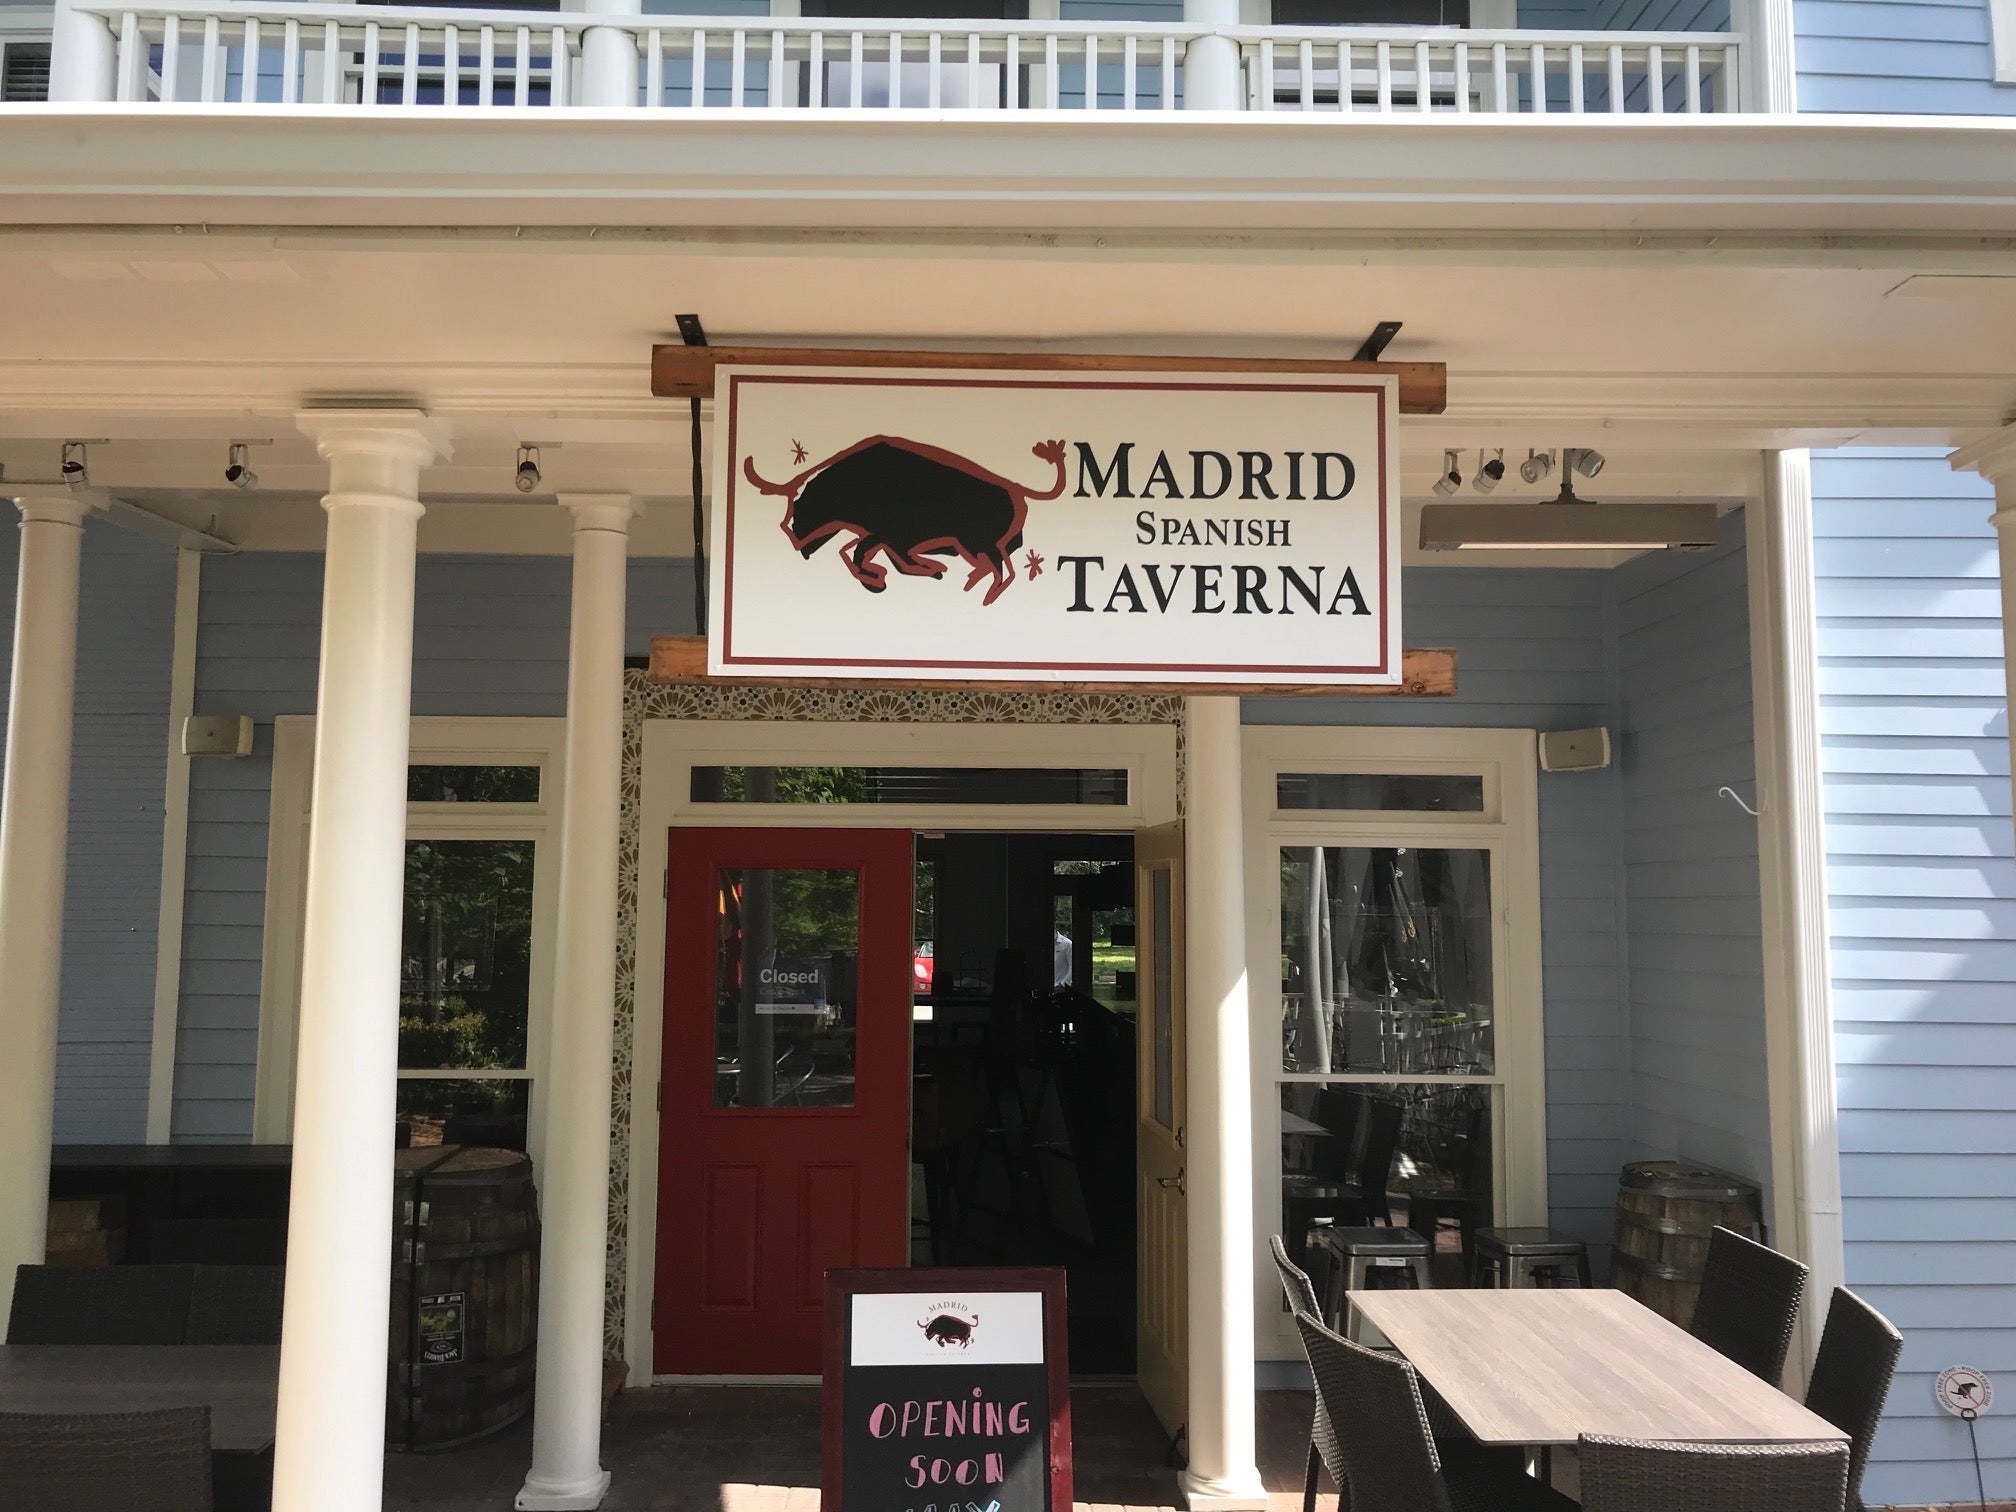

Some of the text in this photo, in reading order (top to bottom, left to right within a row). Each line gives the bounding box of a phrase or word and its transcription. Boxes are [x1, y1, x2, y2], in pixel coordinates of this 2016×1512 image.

[1073, 441, 1356, 500] MADRID
[1135, 510, 1292, 546] SPANISH
[1057, 555, 1372, 615] TAVERNA
[760, 968, 819, 984] Closed
[928, 1301, 968, 1313] MADRID
[905, 1452, 1004, 1489] SOON
